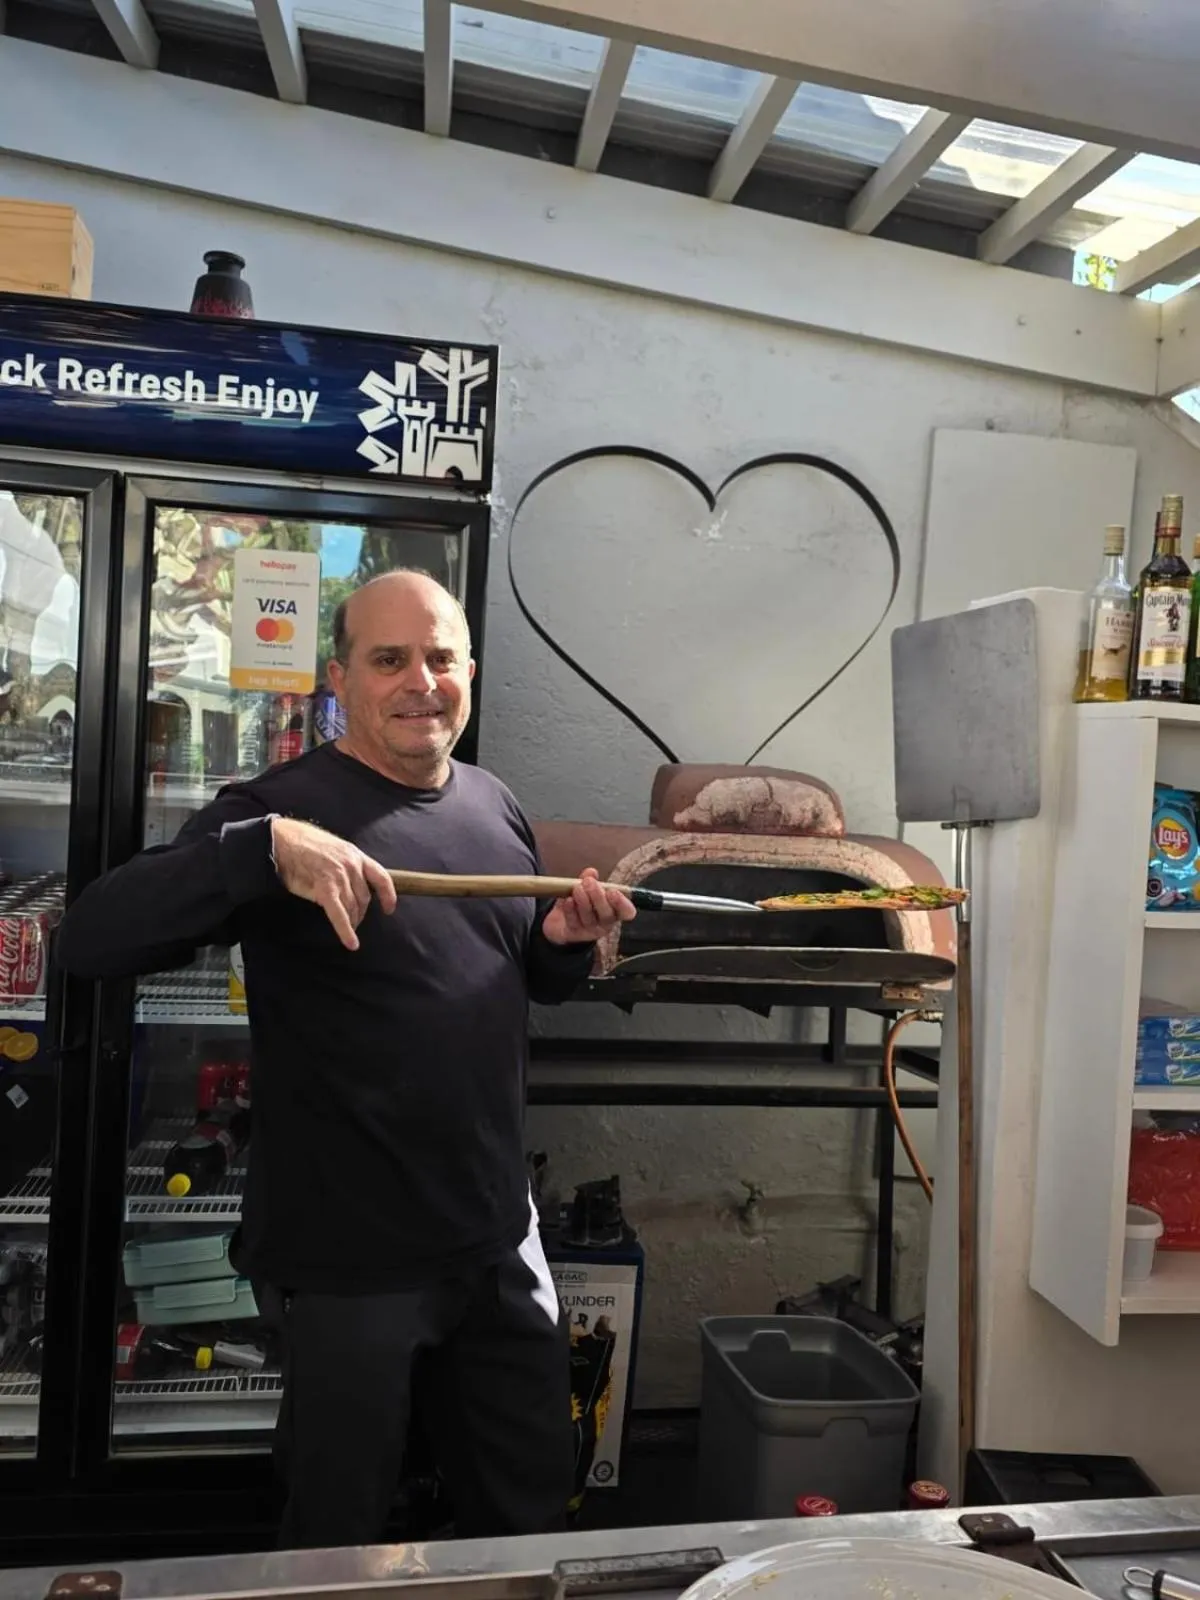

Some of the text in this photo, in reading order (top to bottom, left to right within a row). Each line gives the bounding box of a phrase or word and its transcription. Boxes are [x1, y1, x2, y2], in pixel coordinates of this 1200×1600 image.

[58, 357, 206, 404] Refresh
[218, 374, 319, 423] Enjoy
[257, 598, 297, 614] VISA
